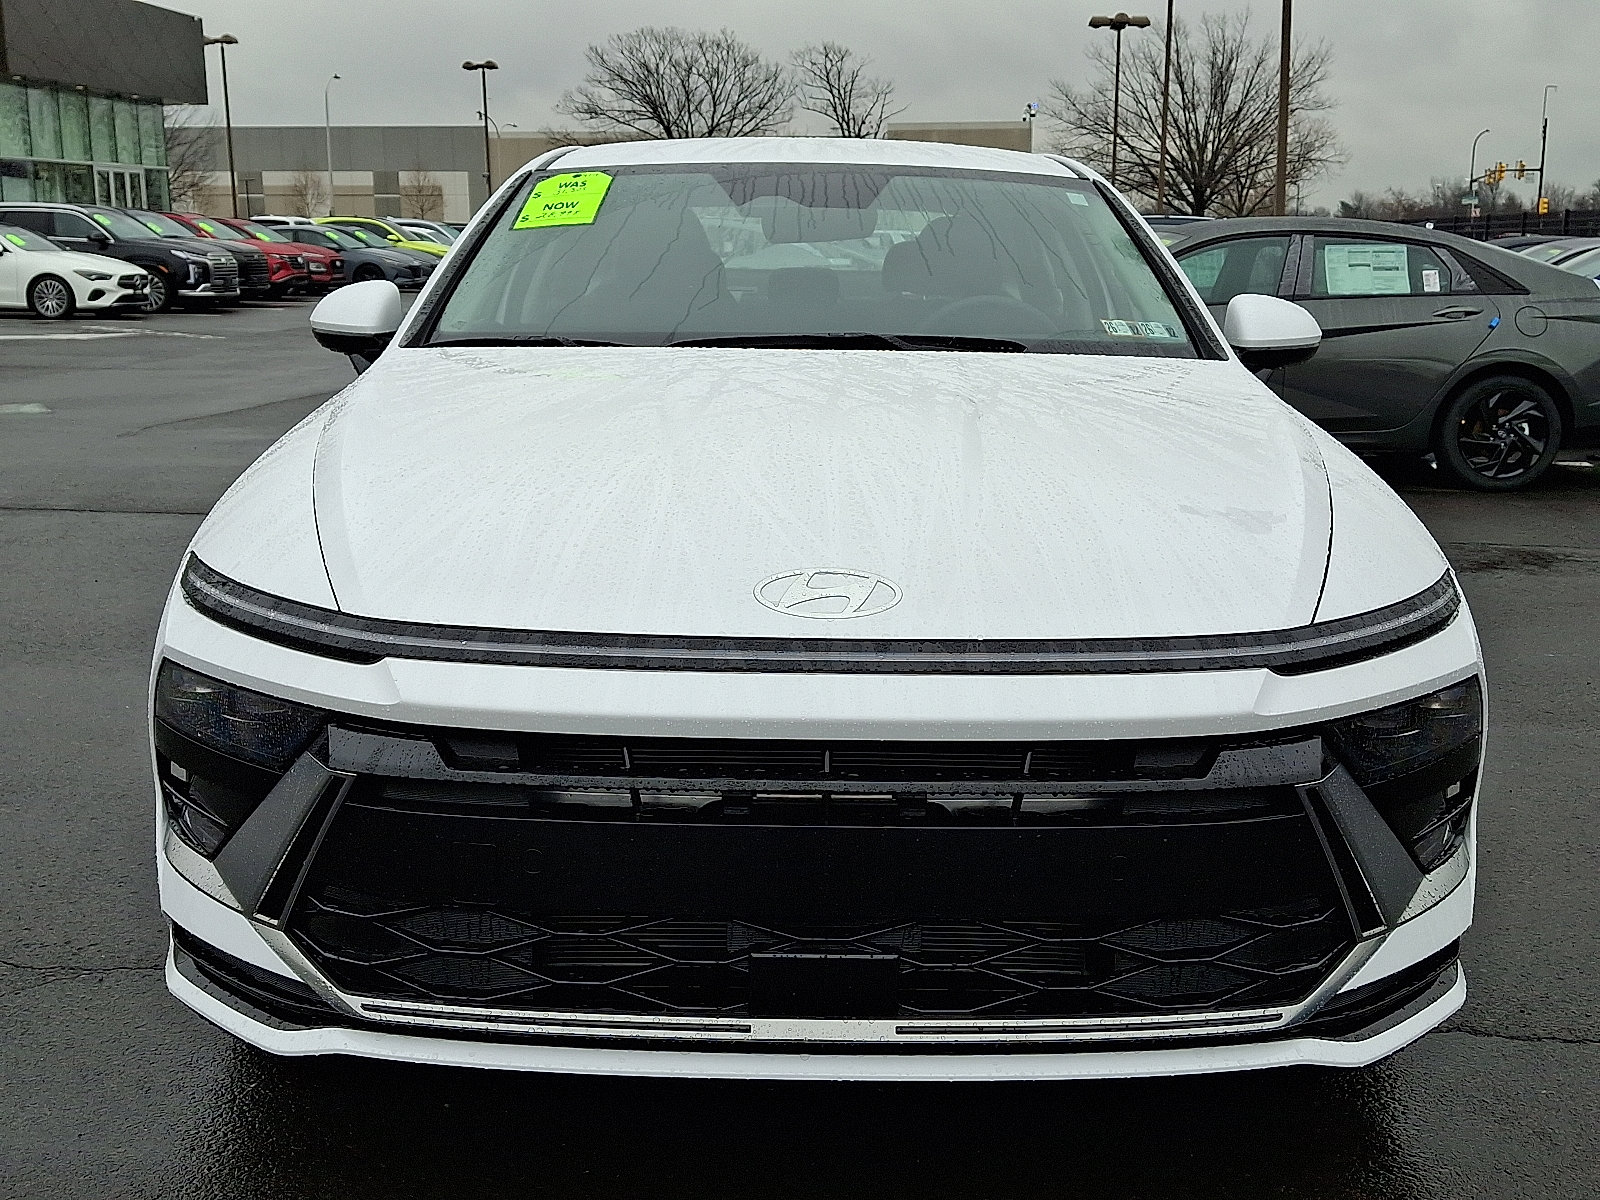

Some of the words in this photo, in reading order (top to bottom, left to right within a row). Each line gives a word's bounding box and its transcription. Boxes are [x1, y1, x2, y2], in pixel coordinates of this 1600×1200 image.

[558, 180, 587, 189] WAS
[542, 201, 579, 211] NOW
[1104, 321, 1117, 334] 26
[1141, 322, 1155, 335] 26
